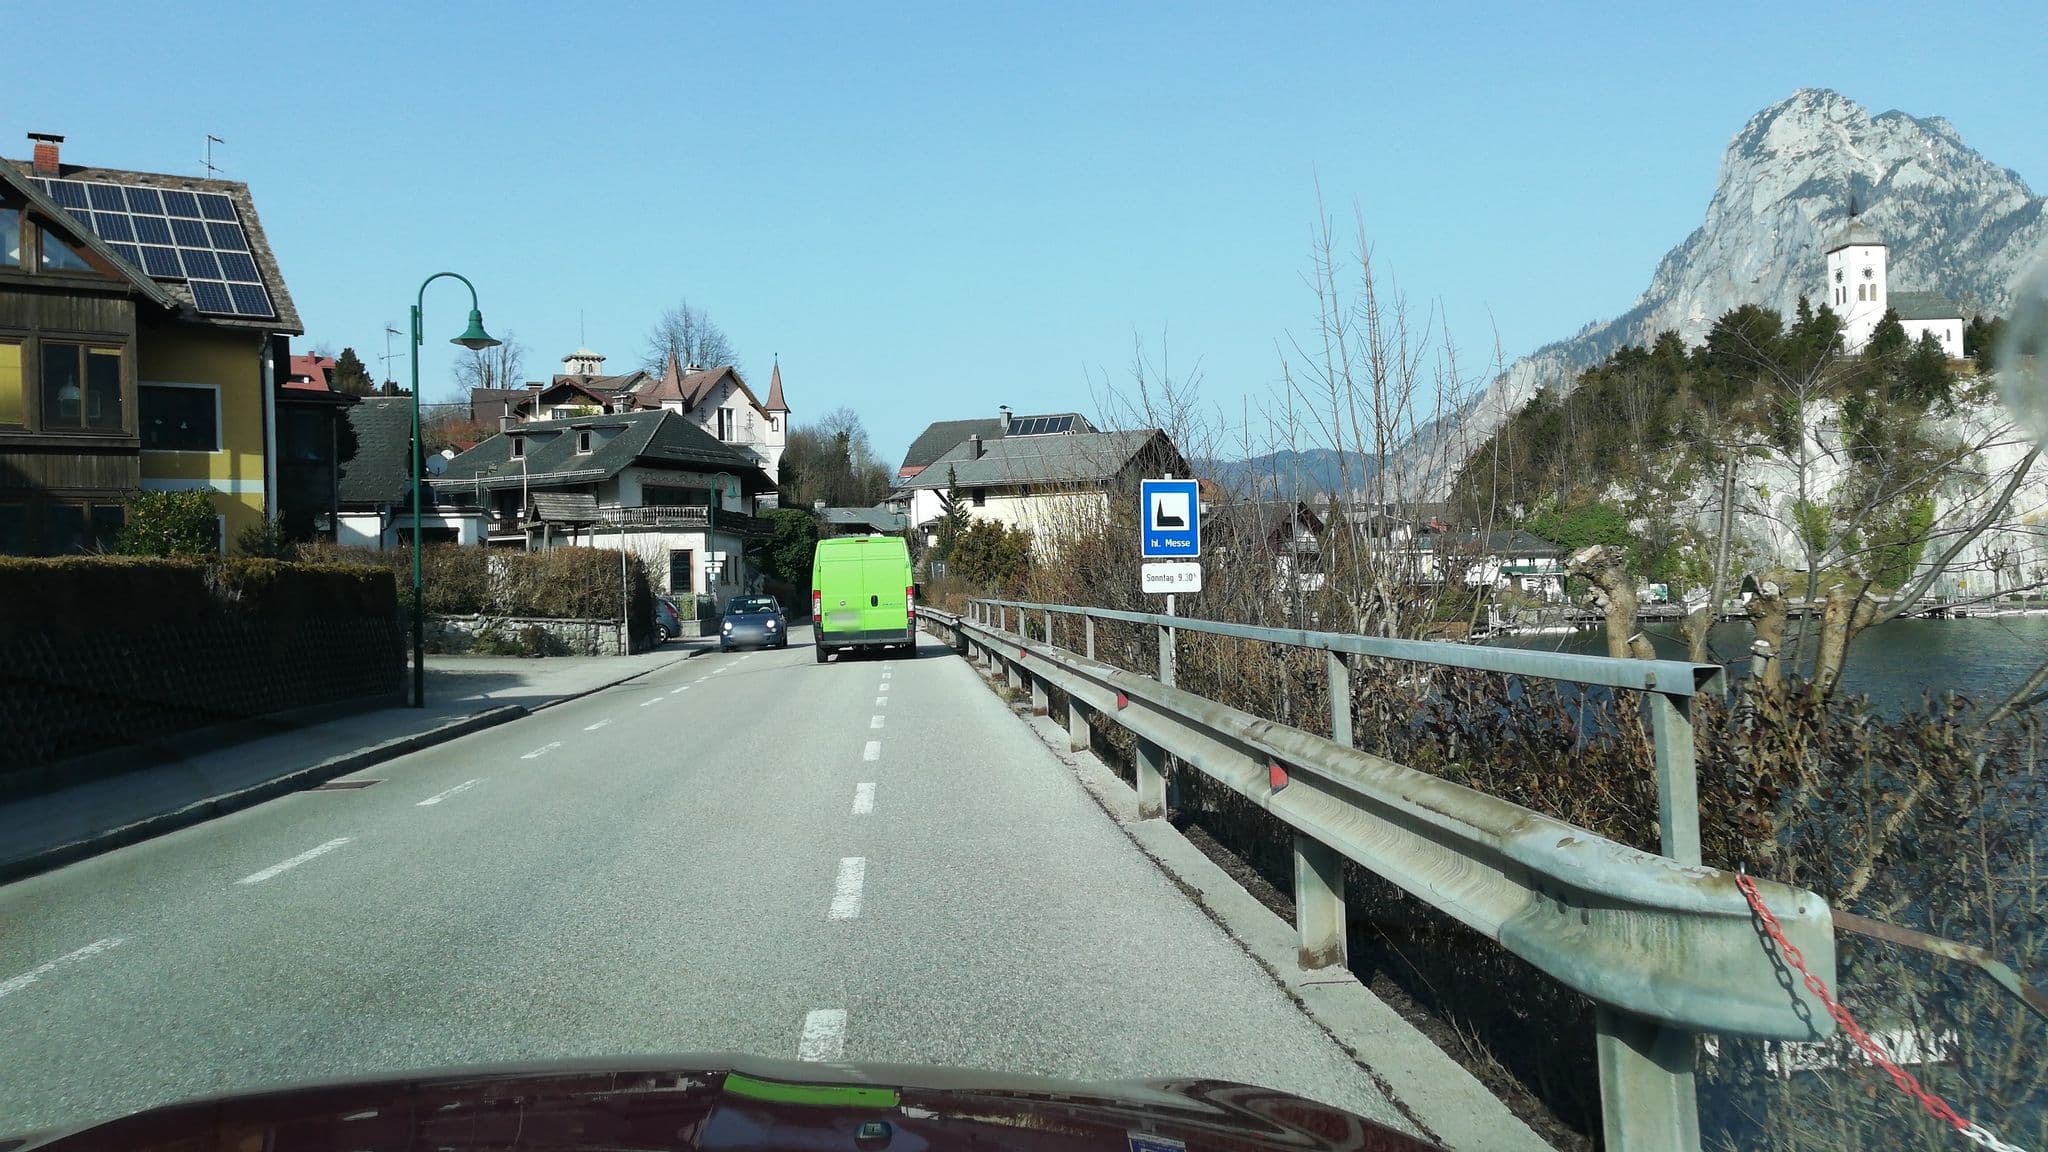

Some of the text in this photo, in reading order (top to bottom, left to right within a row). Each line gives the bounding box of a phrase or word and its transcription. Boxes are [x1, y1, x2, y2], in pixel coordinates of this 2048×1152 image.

[1151, 538, 1191, 548] hl. Messe
[1146, 573, 1174, 584] Sonntag
